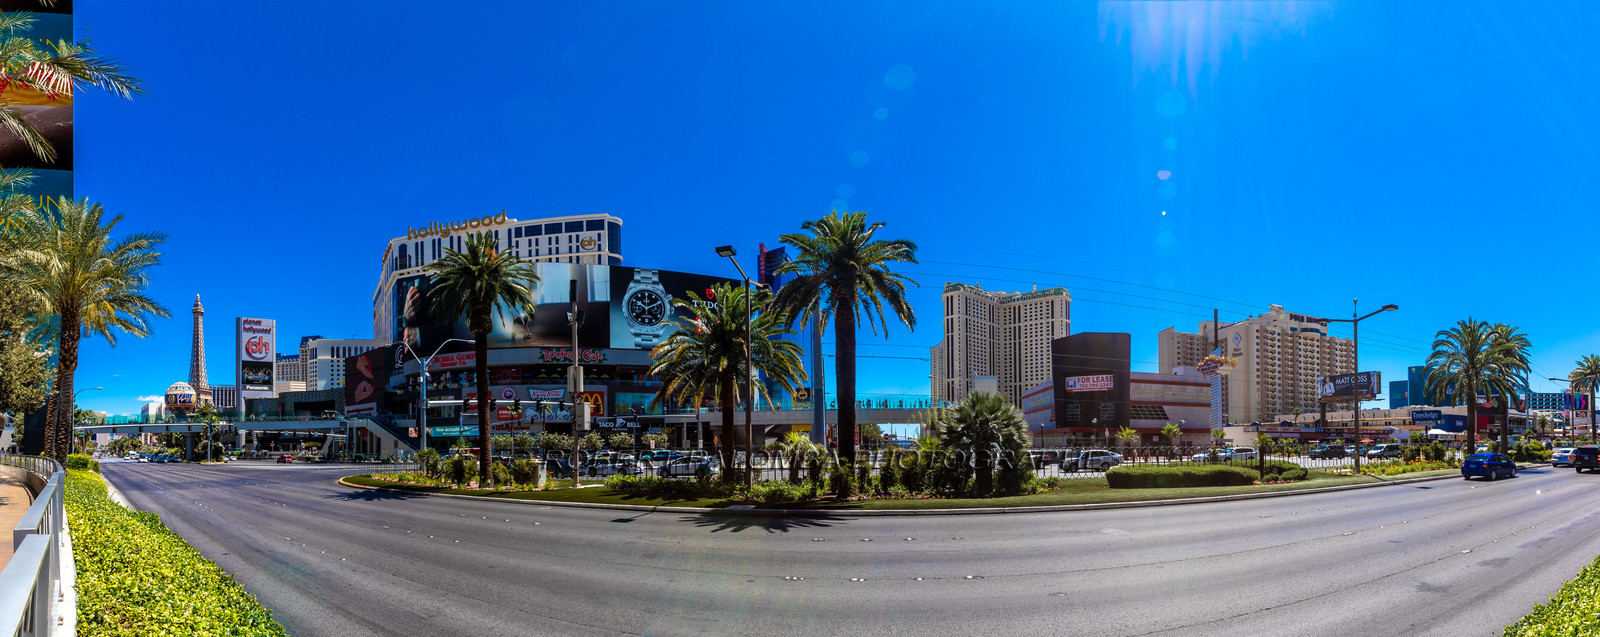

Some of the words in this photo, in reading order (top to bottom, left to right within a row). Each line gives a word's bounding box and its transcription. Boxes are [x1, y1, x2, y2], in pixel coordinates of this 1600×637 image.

[407, 209, 506, 240] hollywood
[1092, 375, 1114, 383] LEASE
[1335, 377, 1350, 385] MATT
[1412, 411, 1438, 420] Travelodge
